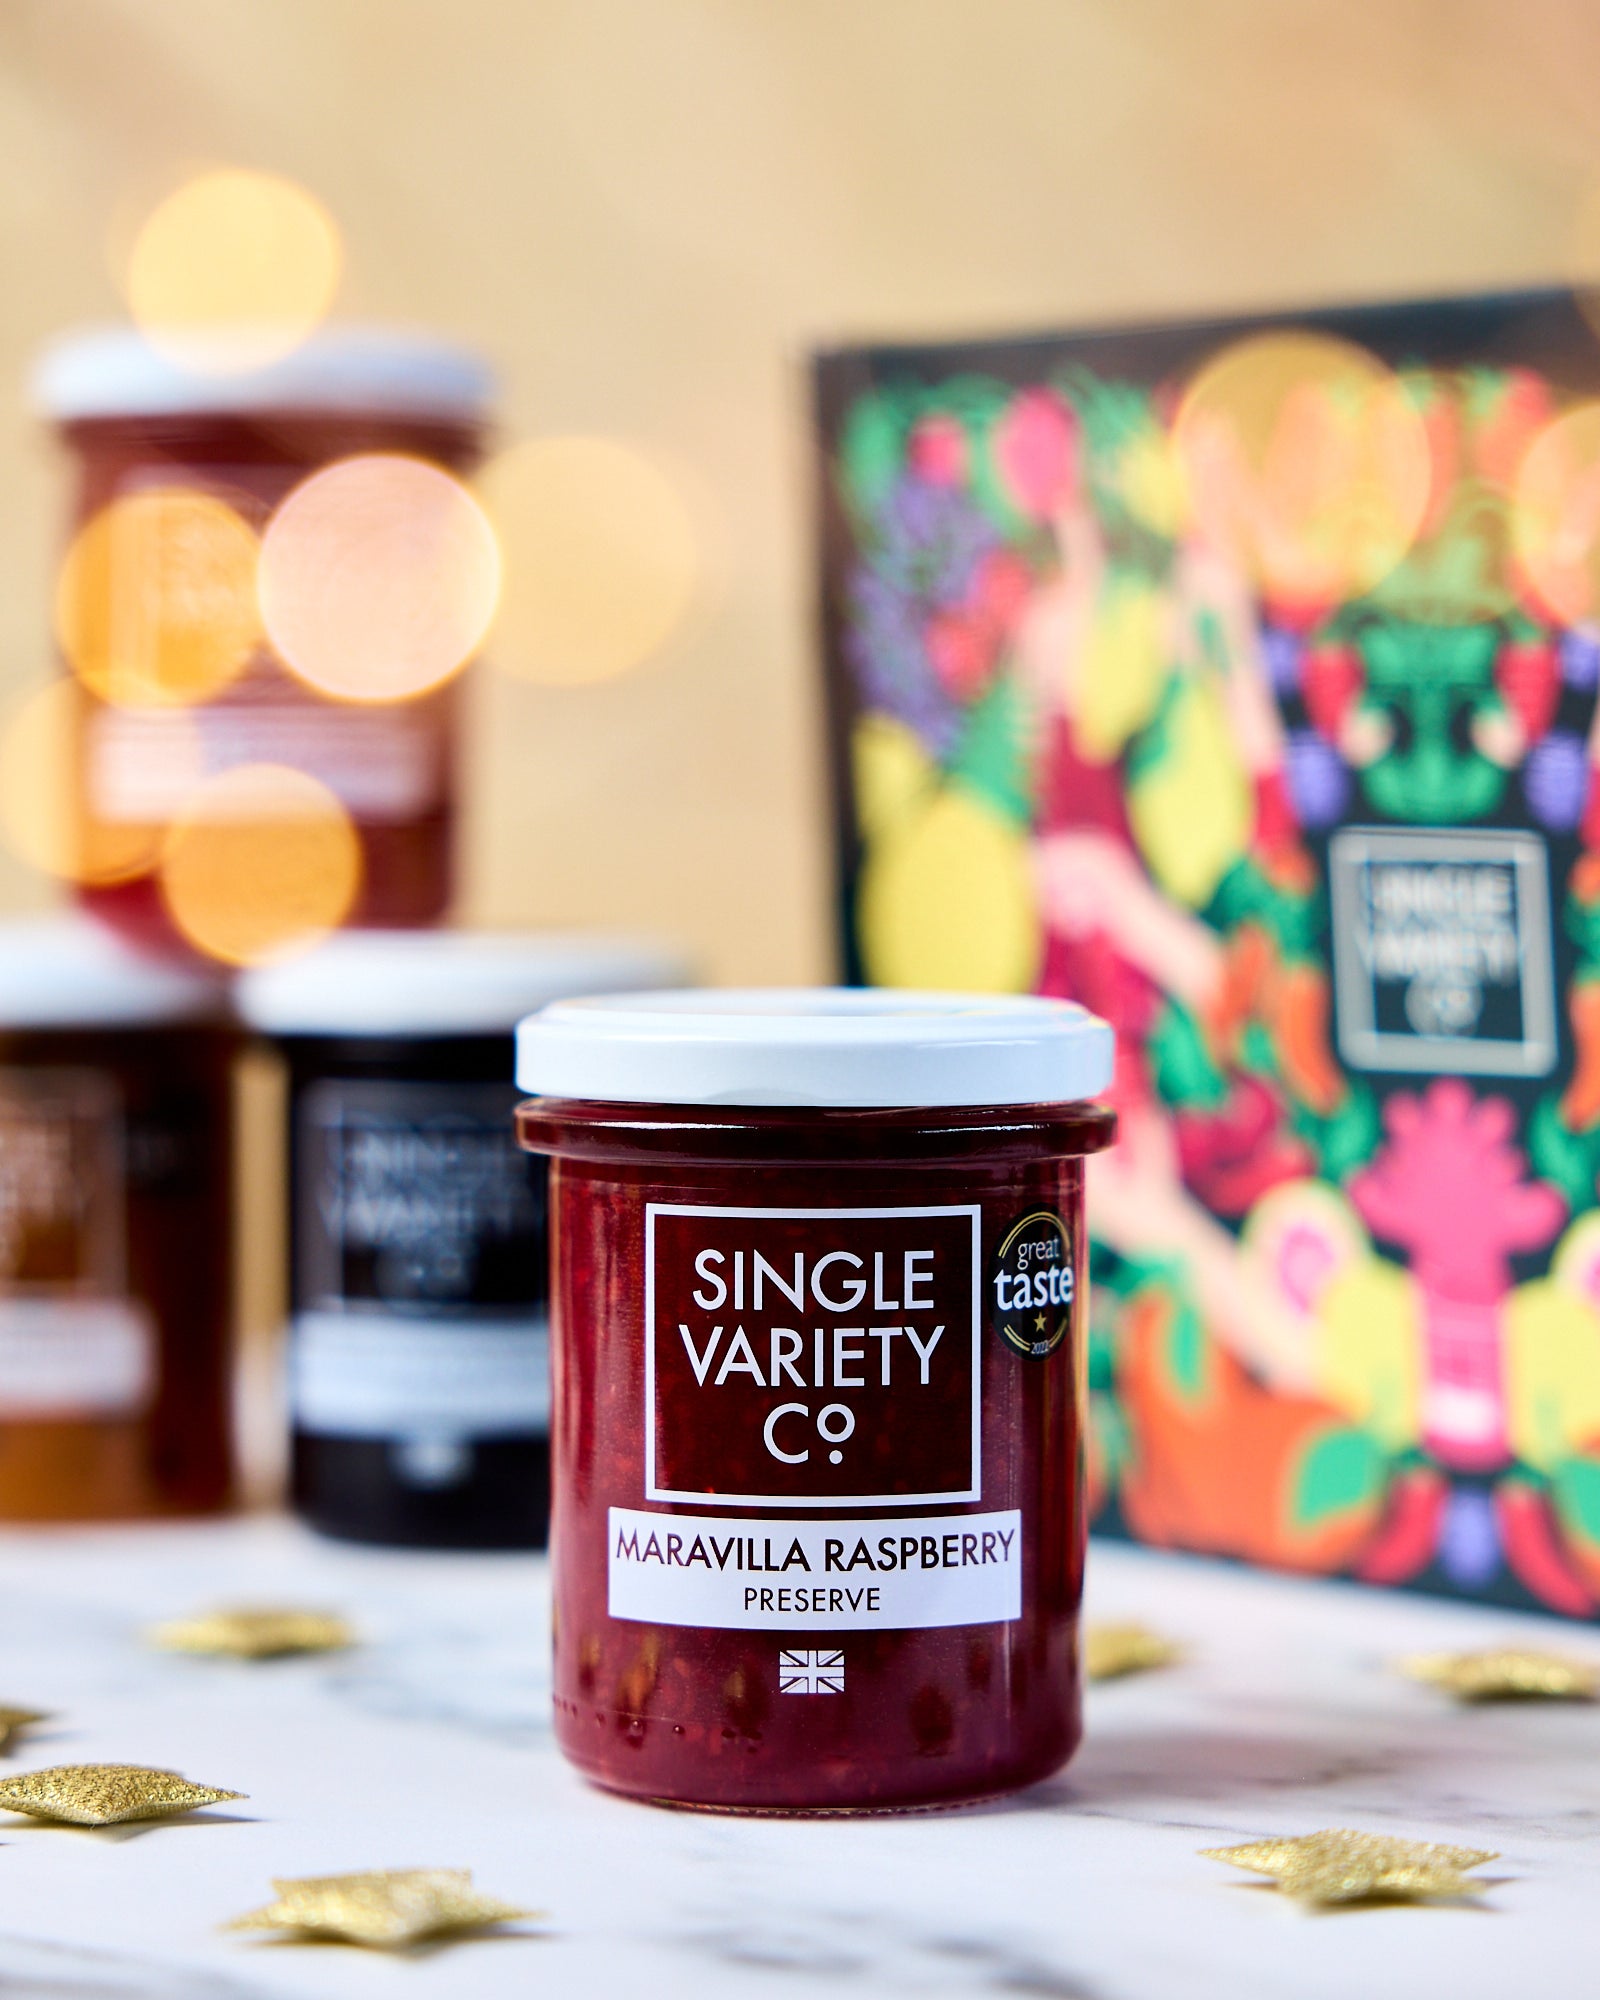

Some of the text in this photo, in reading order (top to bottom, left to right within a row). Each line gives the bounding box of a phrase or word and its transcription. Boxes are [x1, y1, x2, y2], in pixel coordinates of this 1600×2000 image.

[1018, 1238, 1059, 1270] great
[693, 1249, 934, 1312] SINGLE
[993, 1267, 1074, 1310] taste
[679, 1324, 945, 1387] VARIETY
[616, 1526, 1015, 1573] MARAVILLA RASPBERRY
[743, 1587, 881, 1612] PRESERVE
